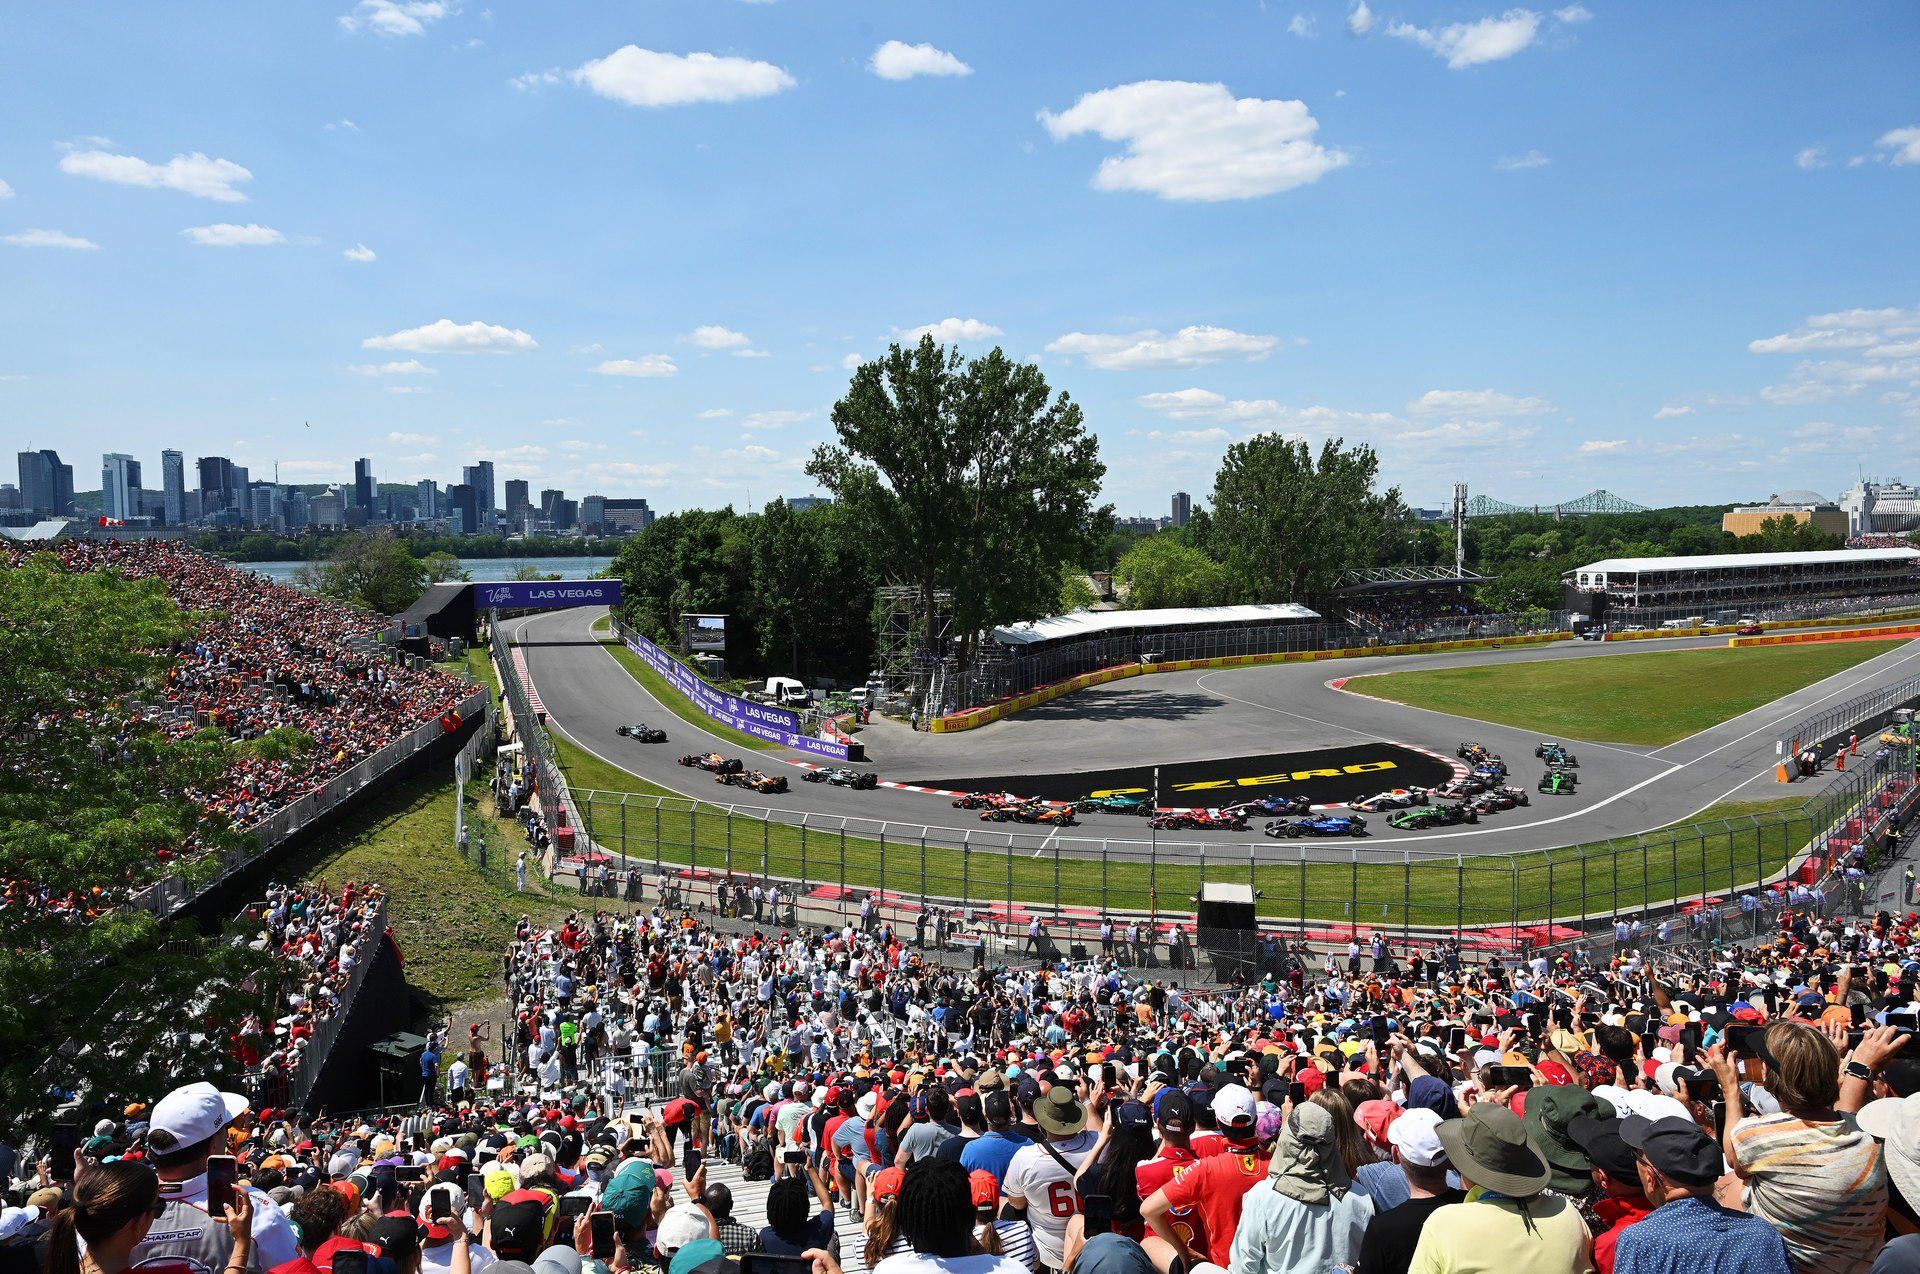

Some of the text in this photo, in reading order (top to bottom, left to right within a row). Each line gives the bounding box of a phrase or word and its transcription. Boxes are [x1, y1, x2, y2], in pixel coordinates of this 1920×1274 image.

[529, 589, 603, 599] LAS VEGAS
[745, 706, 791, 726] LAS VEGAS
[944, 717, 969, 730] PIRELLI
[750, 725, 781, 740] LAS VEGAS
[807, 740, 846, 756] LAS VEGAS
[1171, 760, 1398, 792] ZERO
[142, 1230, 201, 1242] CHAMP CAR
